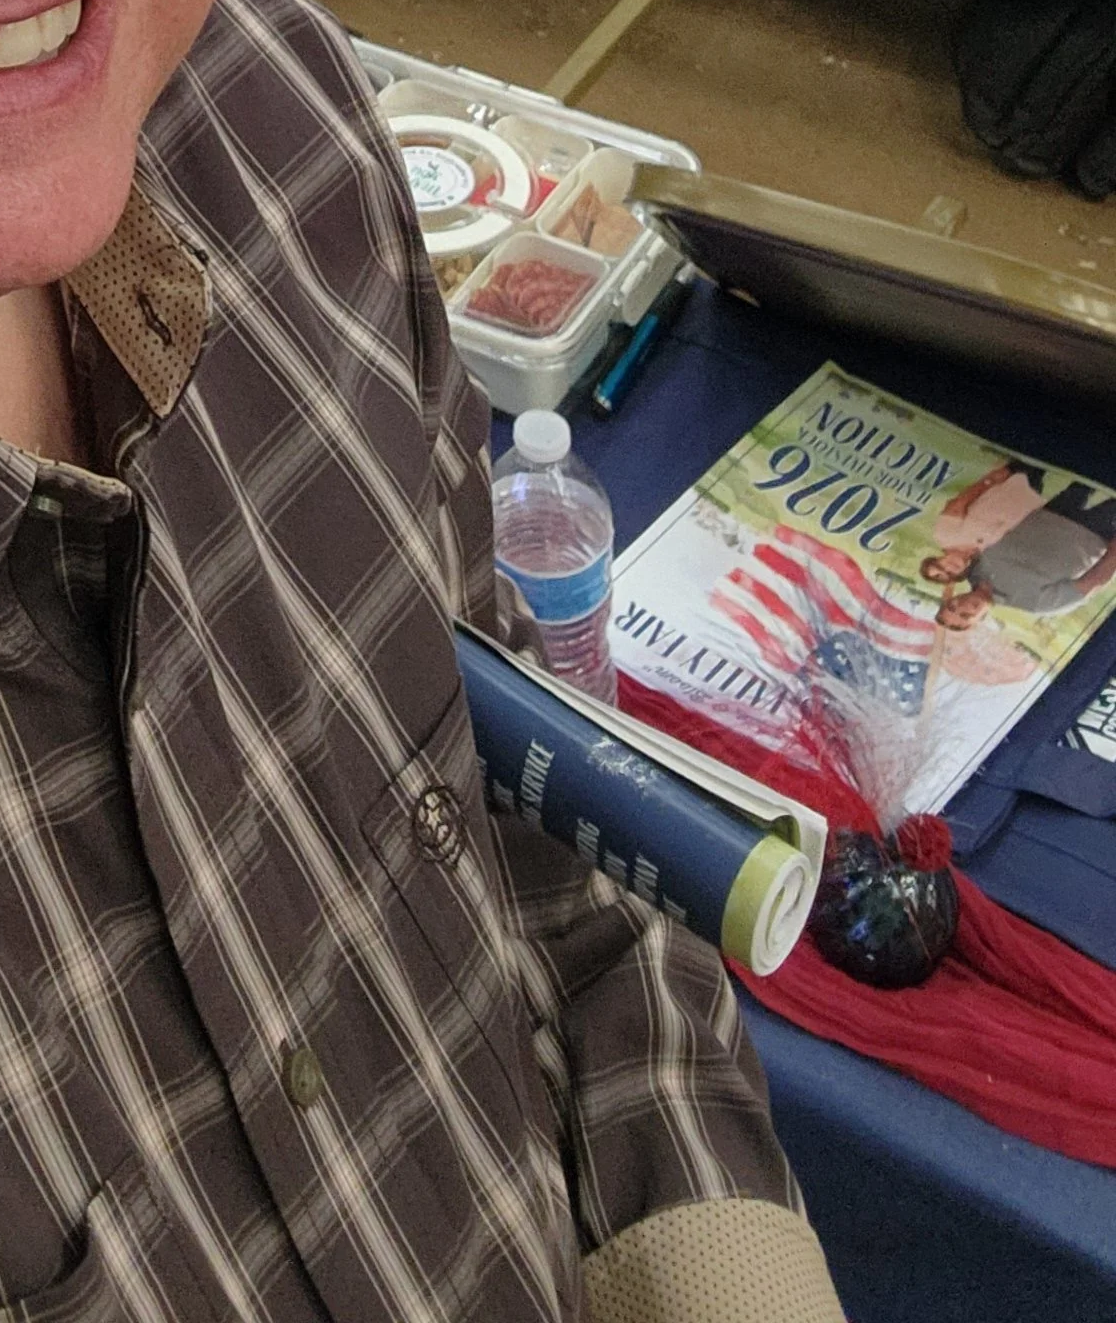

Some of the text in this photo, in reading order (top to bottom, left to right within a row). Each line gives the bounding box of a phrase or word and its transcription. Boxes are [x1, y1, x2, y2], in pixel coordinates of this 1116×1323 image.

[798, 426, 874, 477] LIVESTOCK
[804, 401, 964, 490] AUCTION
[752, 444, 923, 553] 2026
[614, 600, 688, 658] FAIR
[678, 647, 788, 716] VALLEY
